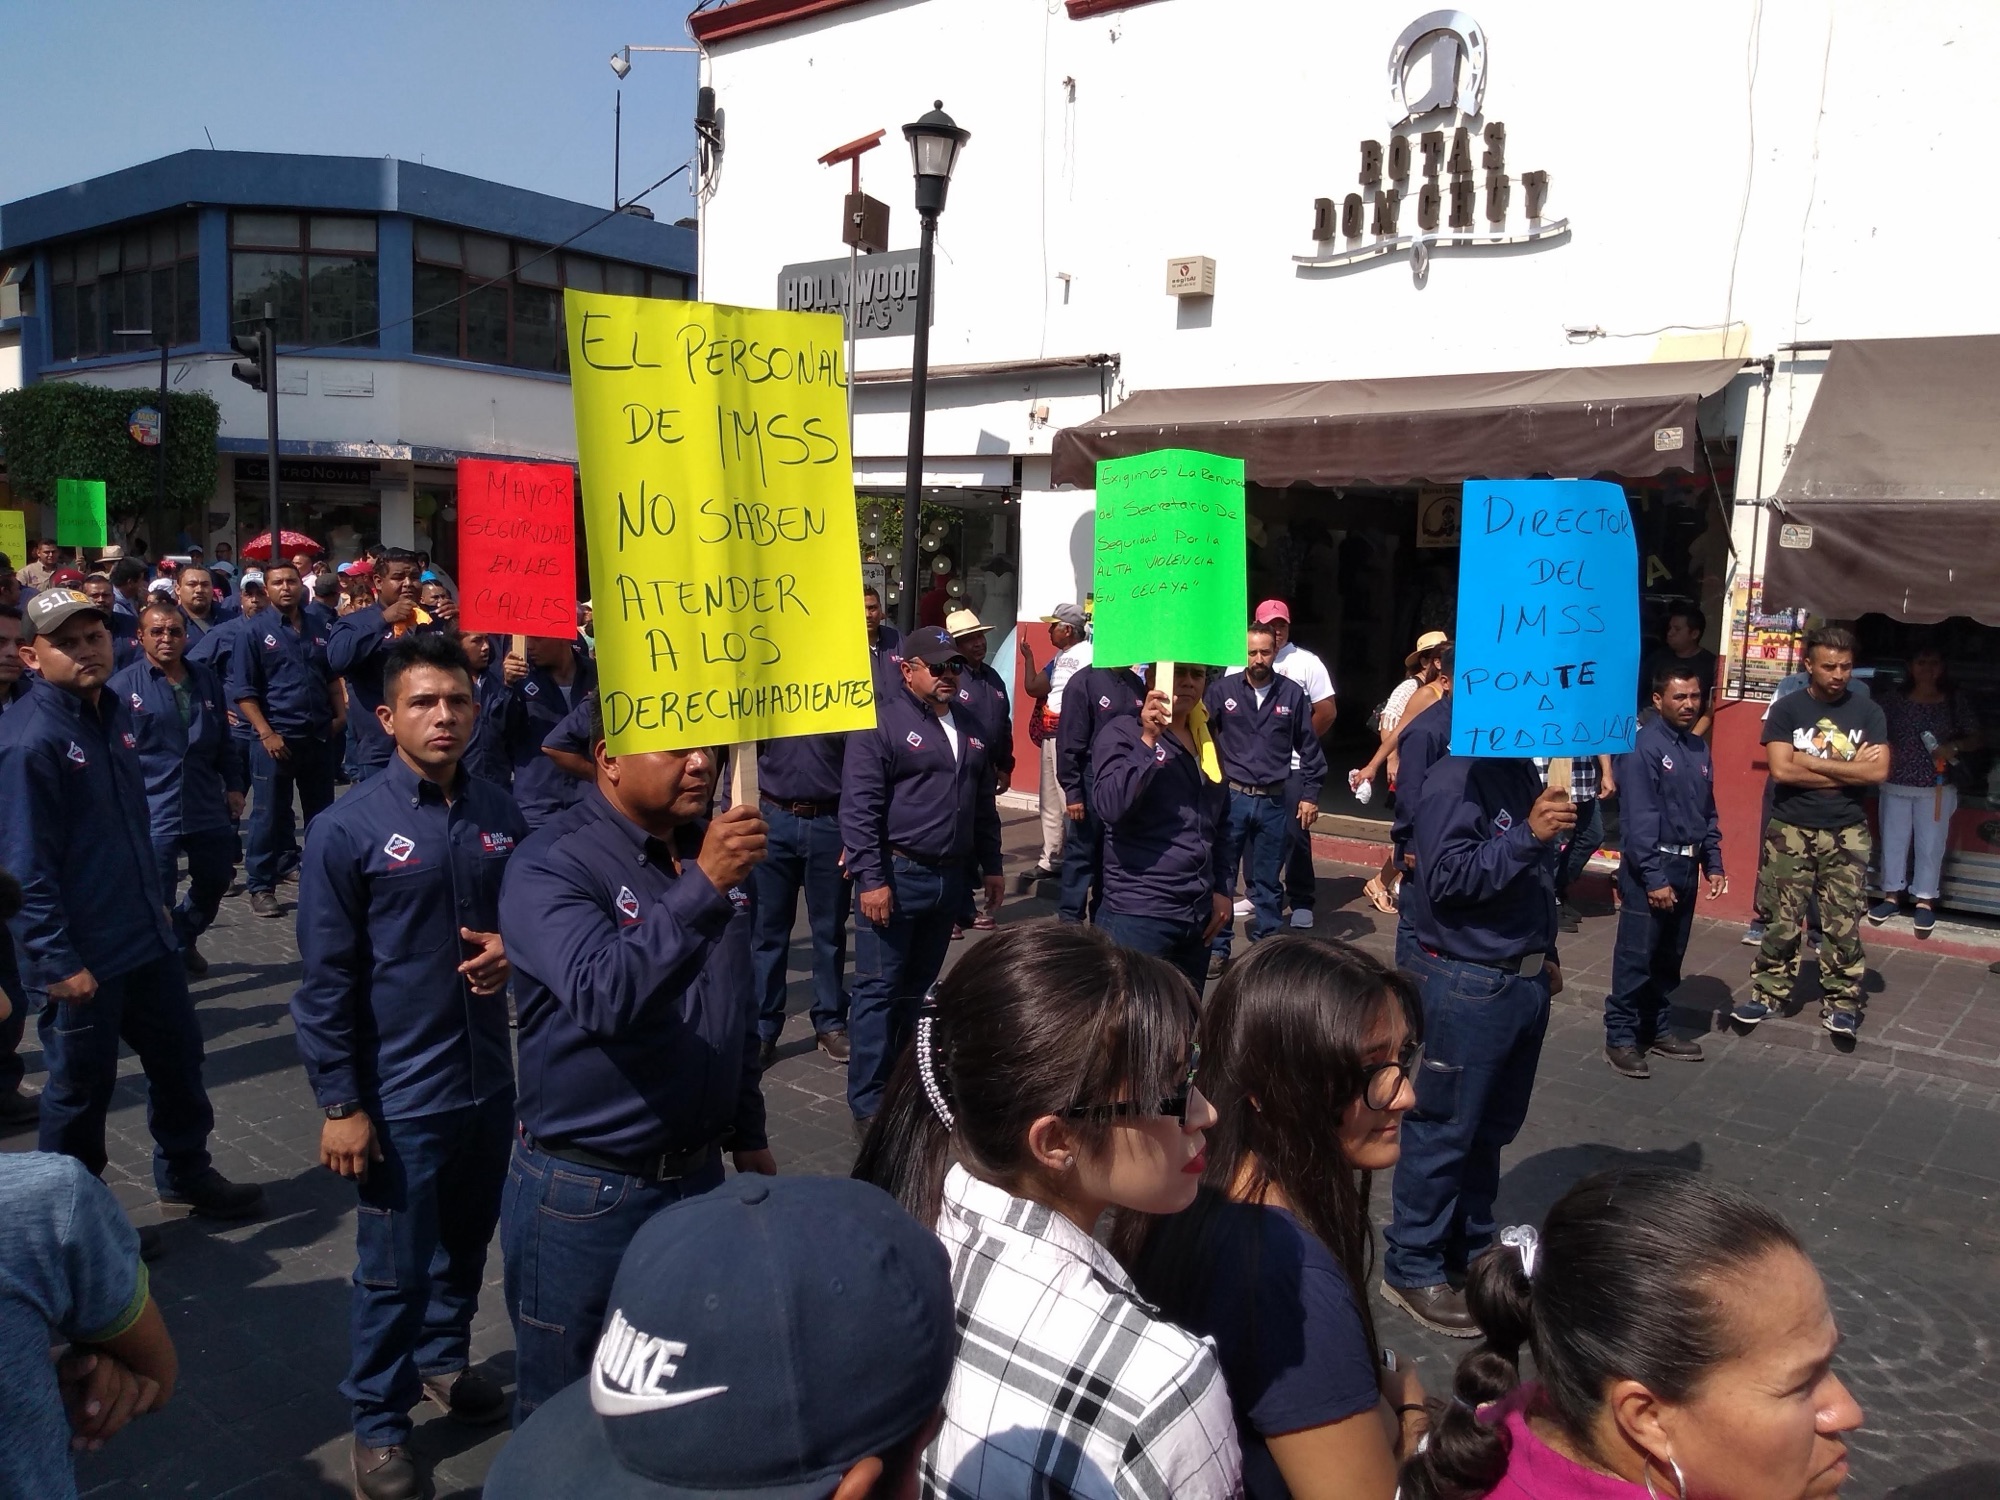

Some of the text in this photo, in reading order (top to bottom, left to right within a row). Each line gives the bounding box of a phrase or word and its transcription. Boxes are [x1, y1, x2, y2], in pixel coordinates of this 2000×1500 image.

[1359, 121, 1505, 186] BOTAS
[1312, 170, 1549, 242] DON CHUY
[784, 263, 920, 311] HOLLYWOOD
[581, 311, 848, 388] EL PERSONAL
[622, 403, 839, 488] DE IMSS
[487, 470, 569, 512] MAYOR
[1101, 465, 1168, 488] Exigimos
[1177, 465, 1196, 478] La
[464, 514, 572, 545] SEGURIDAD
[618, 480, 826, 552] NO SABEN
[1099, 498, 1237, 520] del Secretario De
[1483, 495, 1631, 538] DIRECTOR
[1097, 529, 1158, 554] Seguridad
[1174, 529, 1198, 544] Por
[1145, 553, 1214, 569] VIOLENCIA
[488, 555, 562, 576] EN LAS
[1527, 558, 1594, 590] DEL
[474, 588, 572, 628] CALLES
[616, 574, 810, 622] ATENDER
[1095, 587, 1116, 603] EN
[1497, 603, 1606, 644] IMSS
[645, 624, 781, 672] A LOS
[1763, 647, 1776, 659] VS
[1461, 661, 1598, 695] PONTE
[605, 680, 875, 737] DERECHOHABIENTES
[1464, 714, 1635, 755] TRABAJAR
[598, 1308, 688, 1396] NIKE
